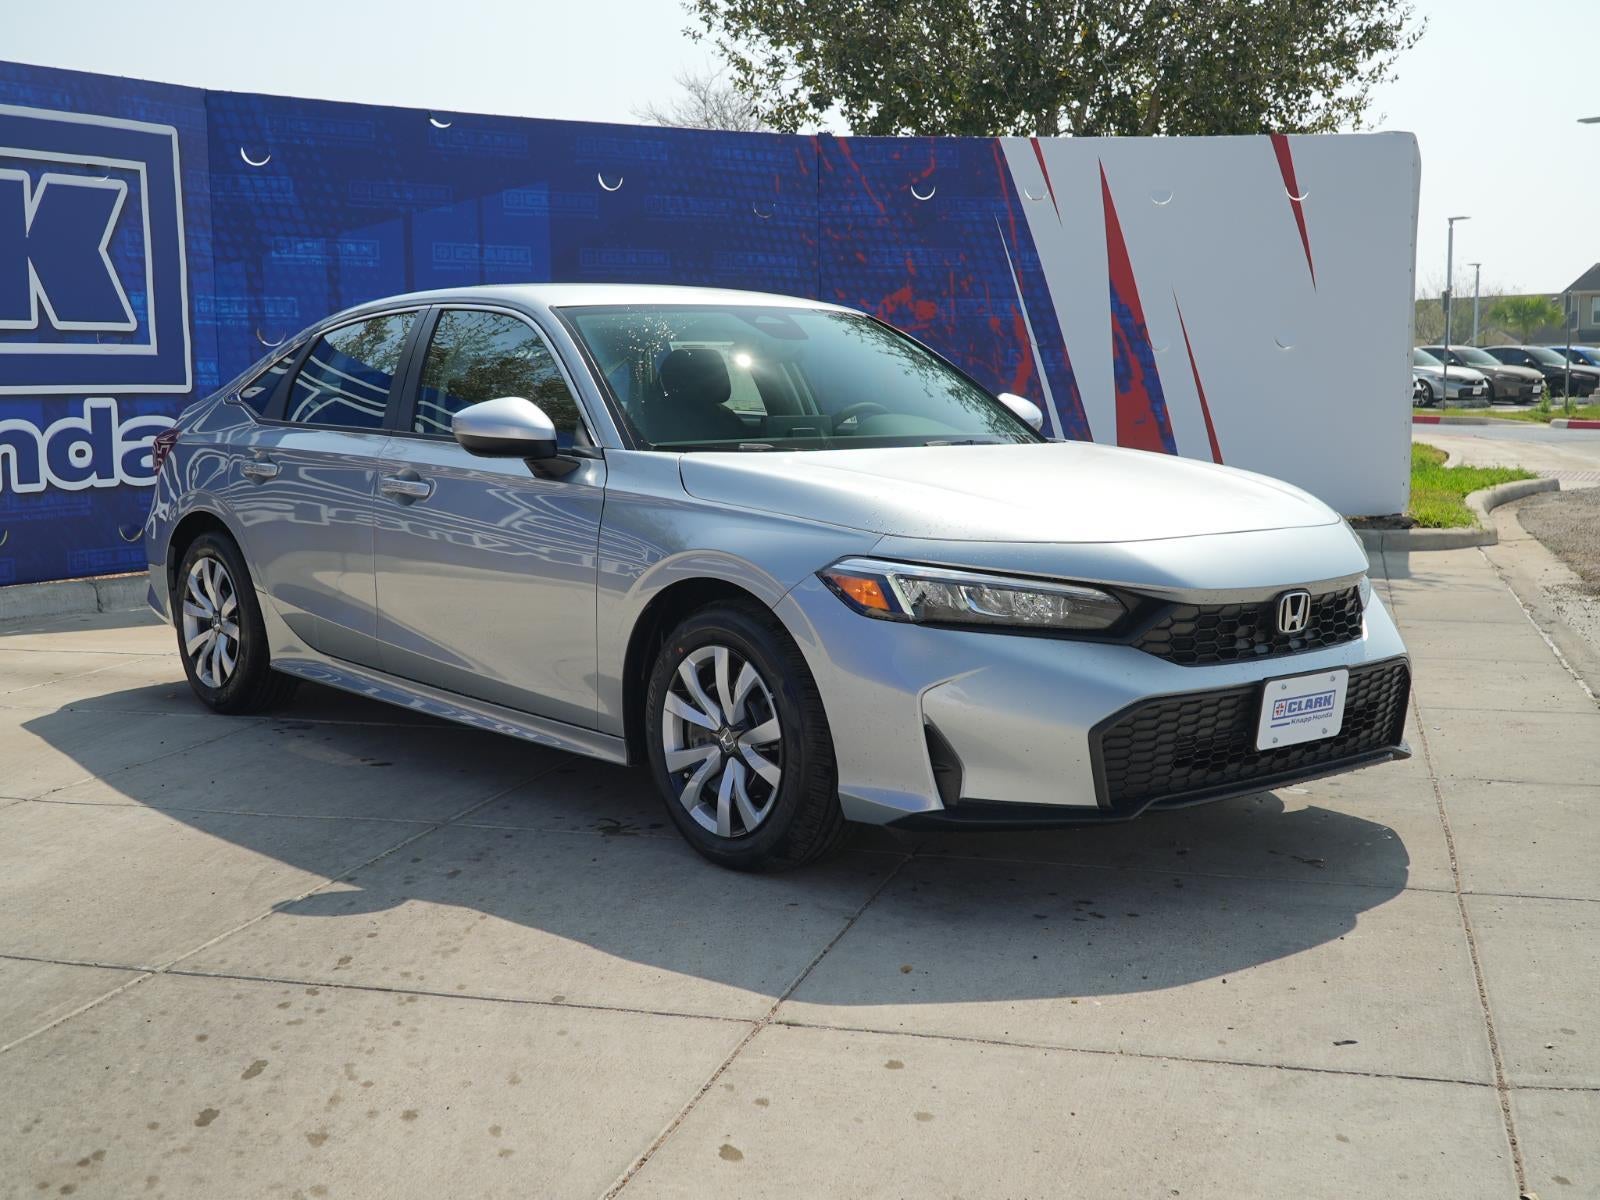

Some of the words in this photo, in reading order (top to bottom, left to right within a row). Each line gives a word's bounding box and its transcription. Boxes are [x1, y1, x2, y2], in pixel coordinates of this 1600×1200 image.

[0, 168, 137, 331] K
[0, 397, 176, 493] nda
[1288, 695, 1332, 713] CLARK
[1290, 716, 1312, 726] Knapp
[1312, 712, 1333, 722] Honda
